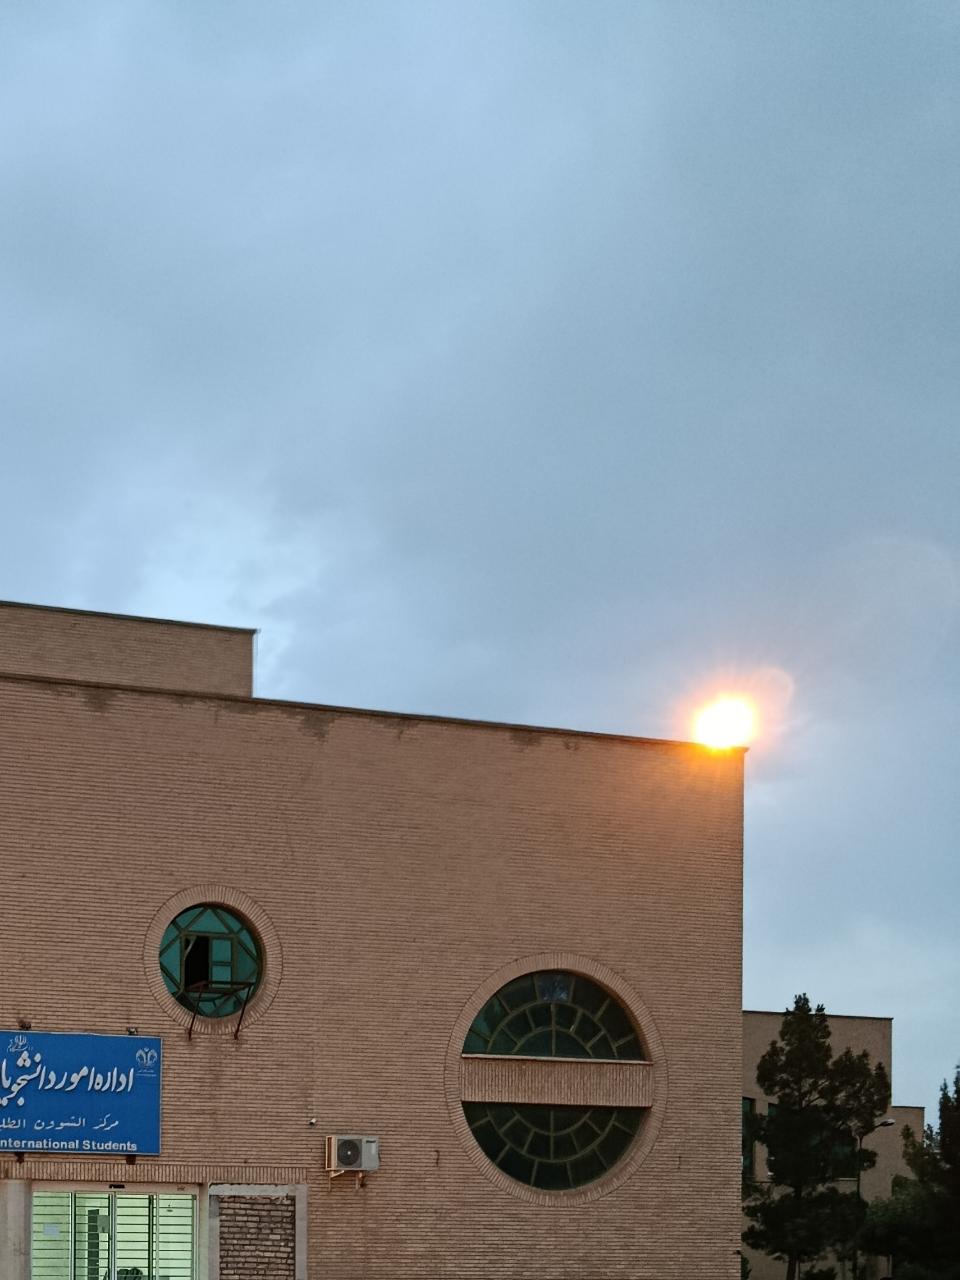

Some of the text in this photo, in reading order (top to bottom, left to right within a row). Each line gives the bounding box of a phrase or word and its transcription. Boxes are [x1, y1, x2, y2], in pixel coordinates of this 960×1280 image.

[54, 1065, 95, 1091] امور
[93, 1066, 135, 1092] اداره
[82, 1139, 138, 1151] Students
